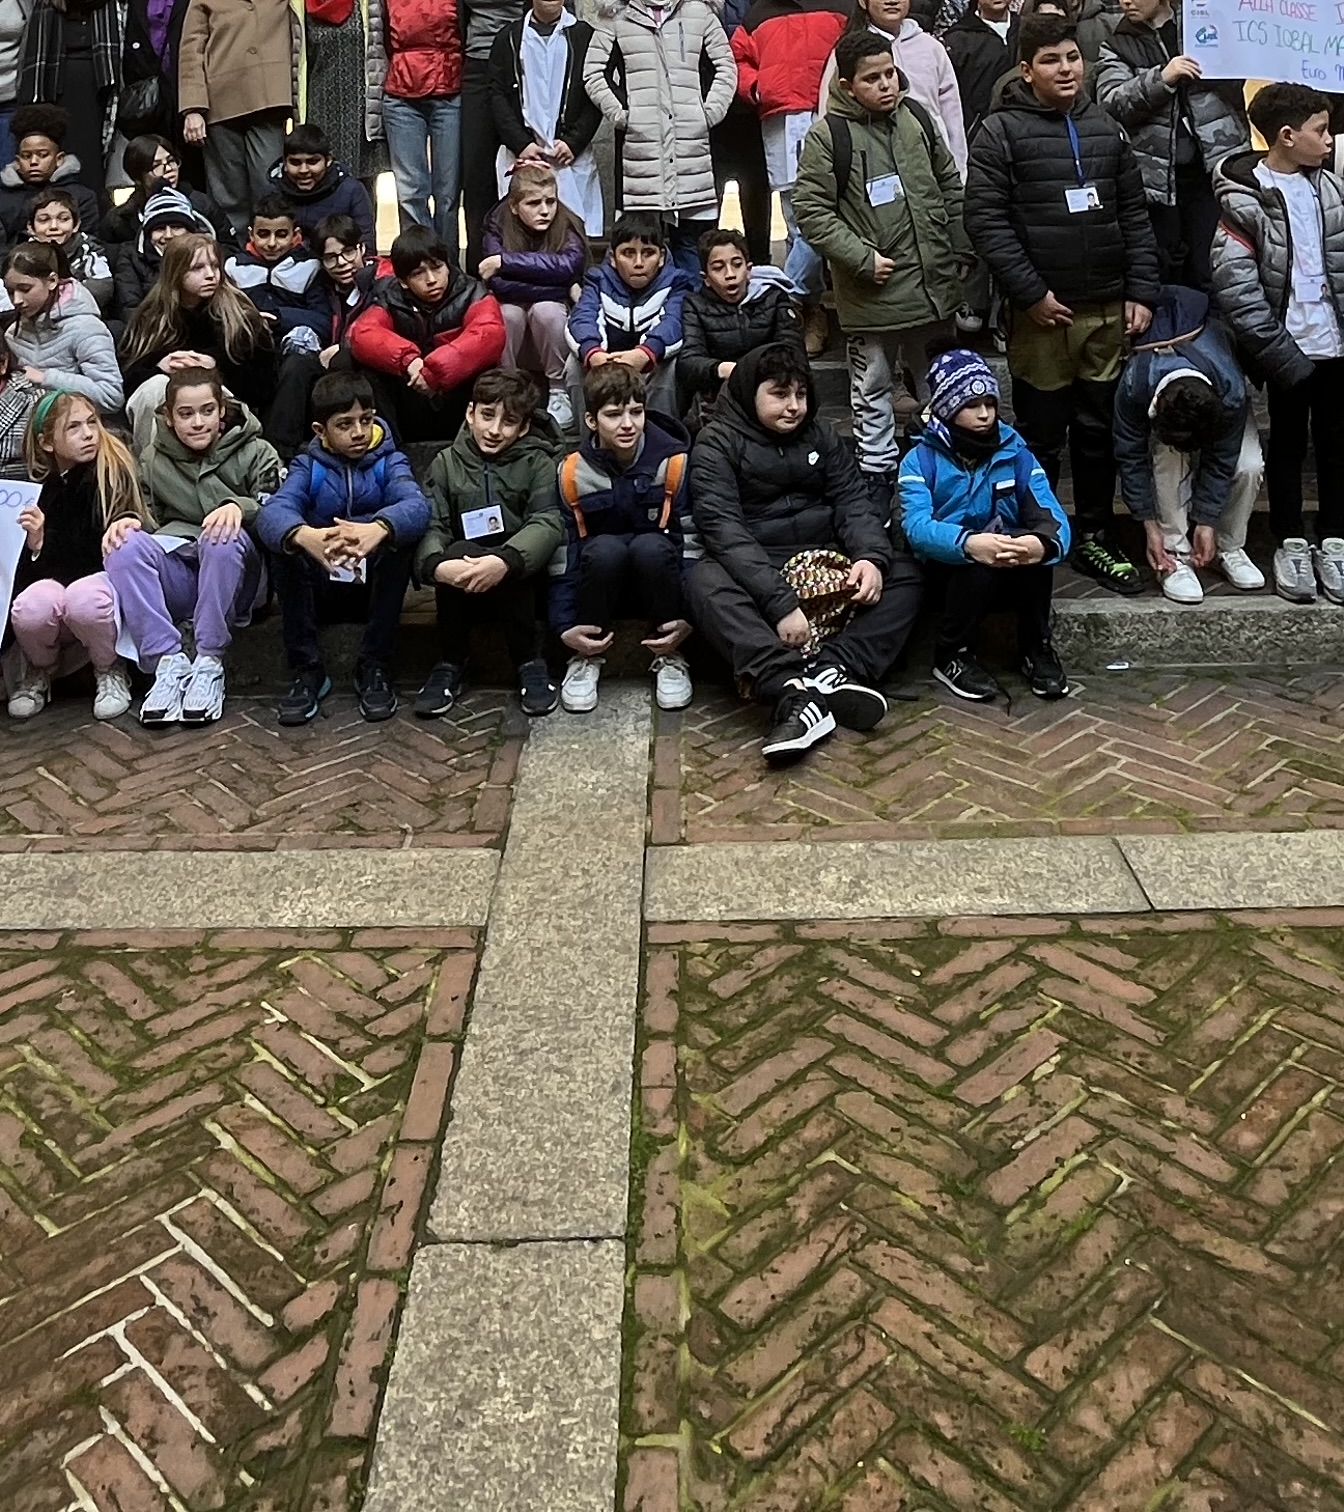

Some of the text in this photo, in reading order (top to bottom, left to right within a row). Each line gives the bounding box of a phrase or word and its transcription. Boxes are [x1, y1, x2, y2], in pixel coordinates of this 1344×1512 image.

[1279, 0, 1318, 22] CLASSE
[1232, 20, 1268, 45] ICS
[1272, 24, 1320, 54] IQBAL
[1301, 59, 1327, 80] Euro
